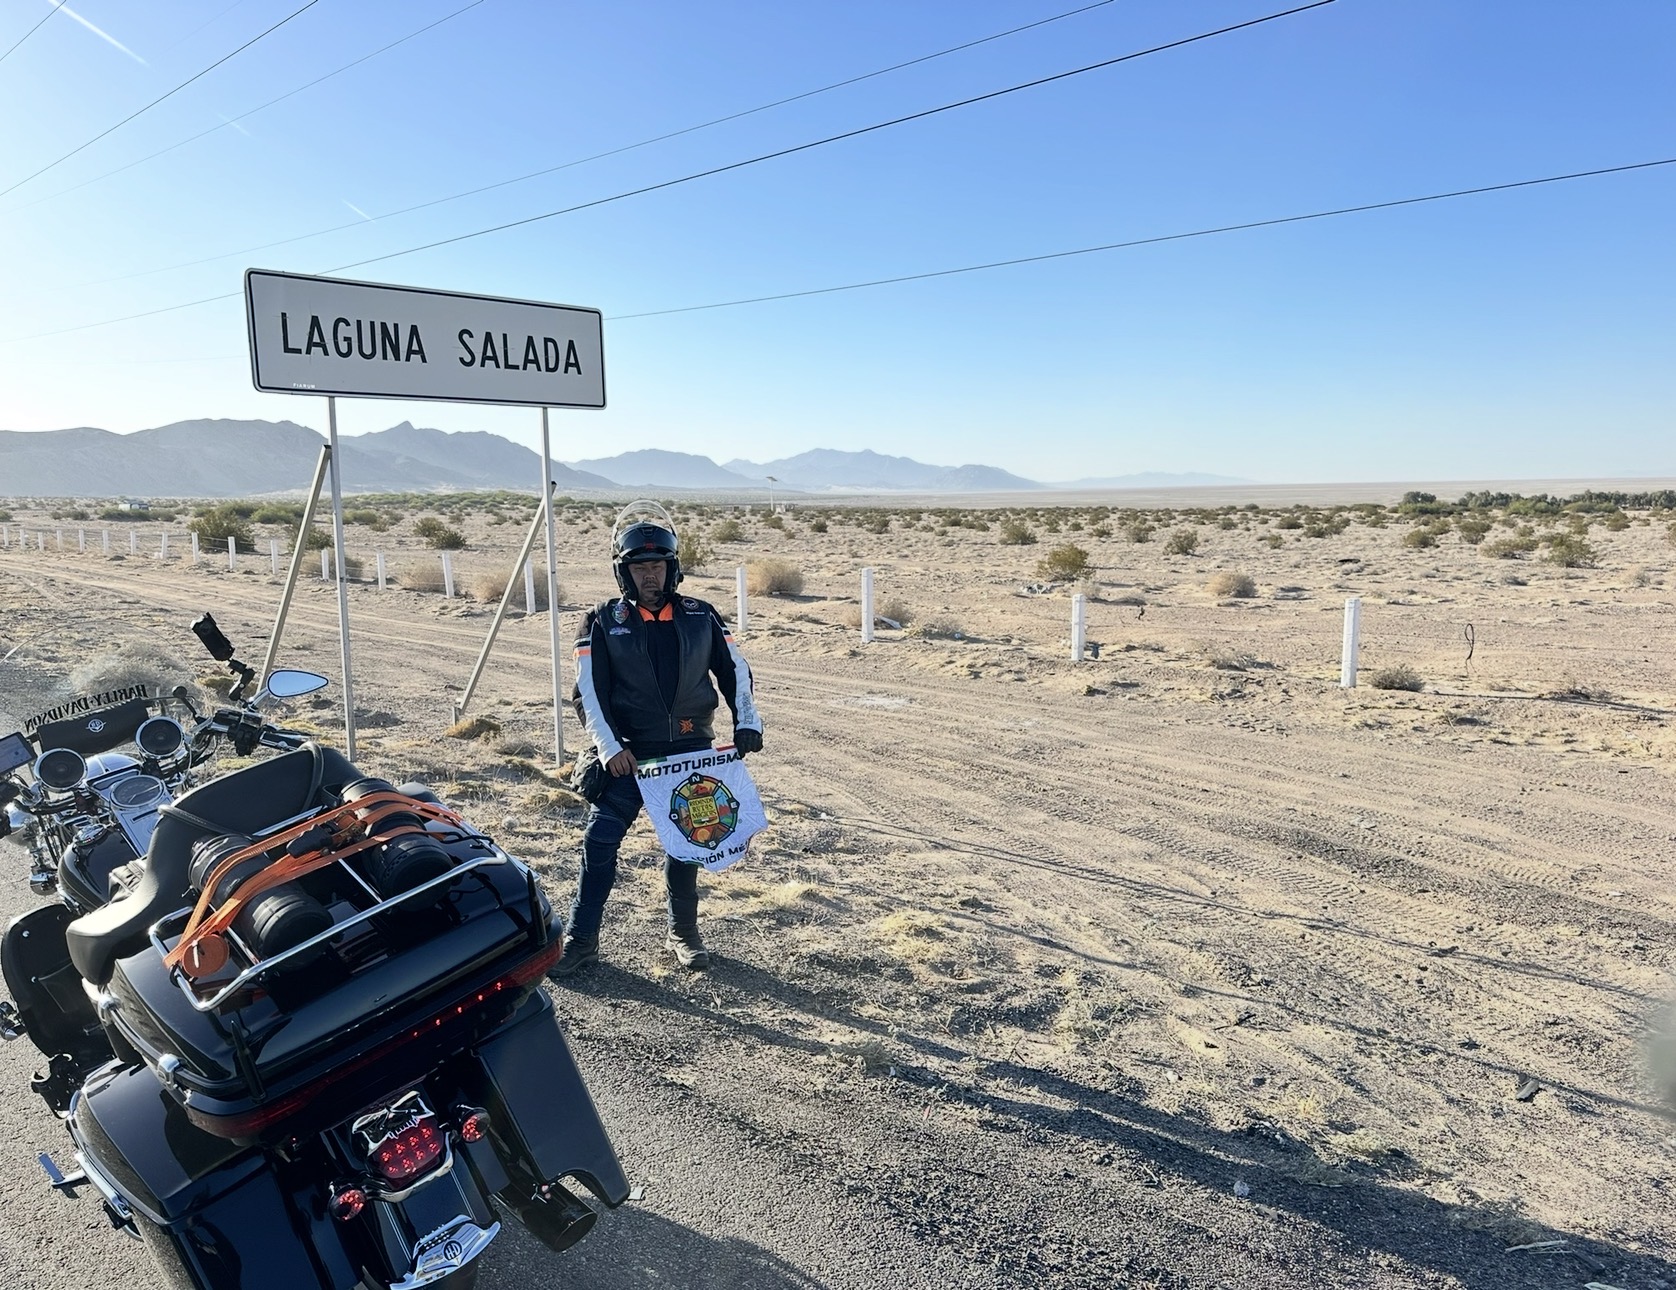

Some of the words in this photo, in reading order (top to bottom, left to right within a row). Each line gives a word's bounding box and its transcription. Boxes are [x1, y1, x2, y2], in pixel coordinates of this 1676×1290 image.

[280, 312, 428, 363] LAGUNA
[457, 328, 583, 375] SALADA
[637, 752, 741, 780] MOTOTURISM
